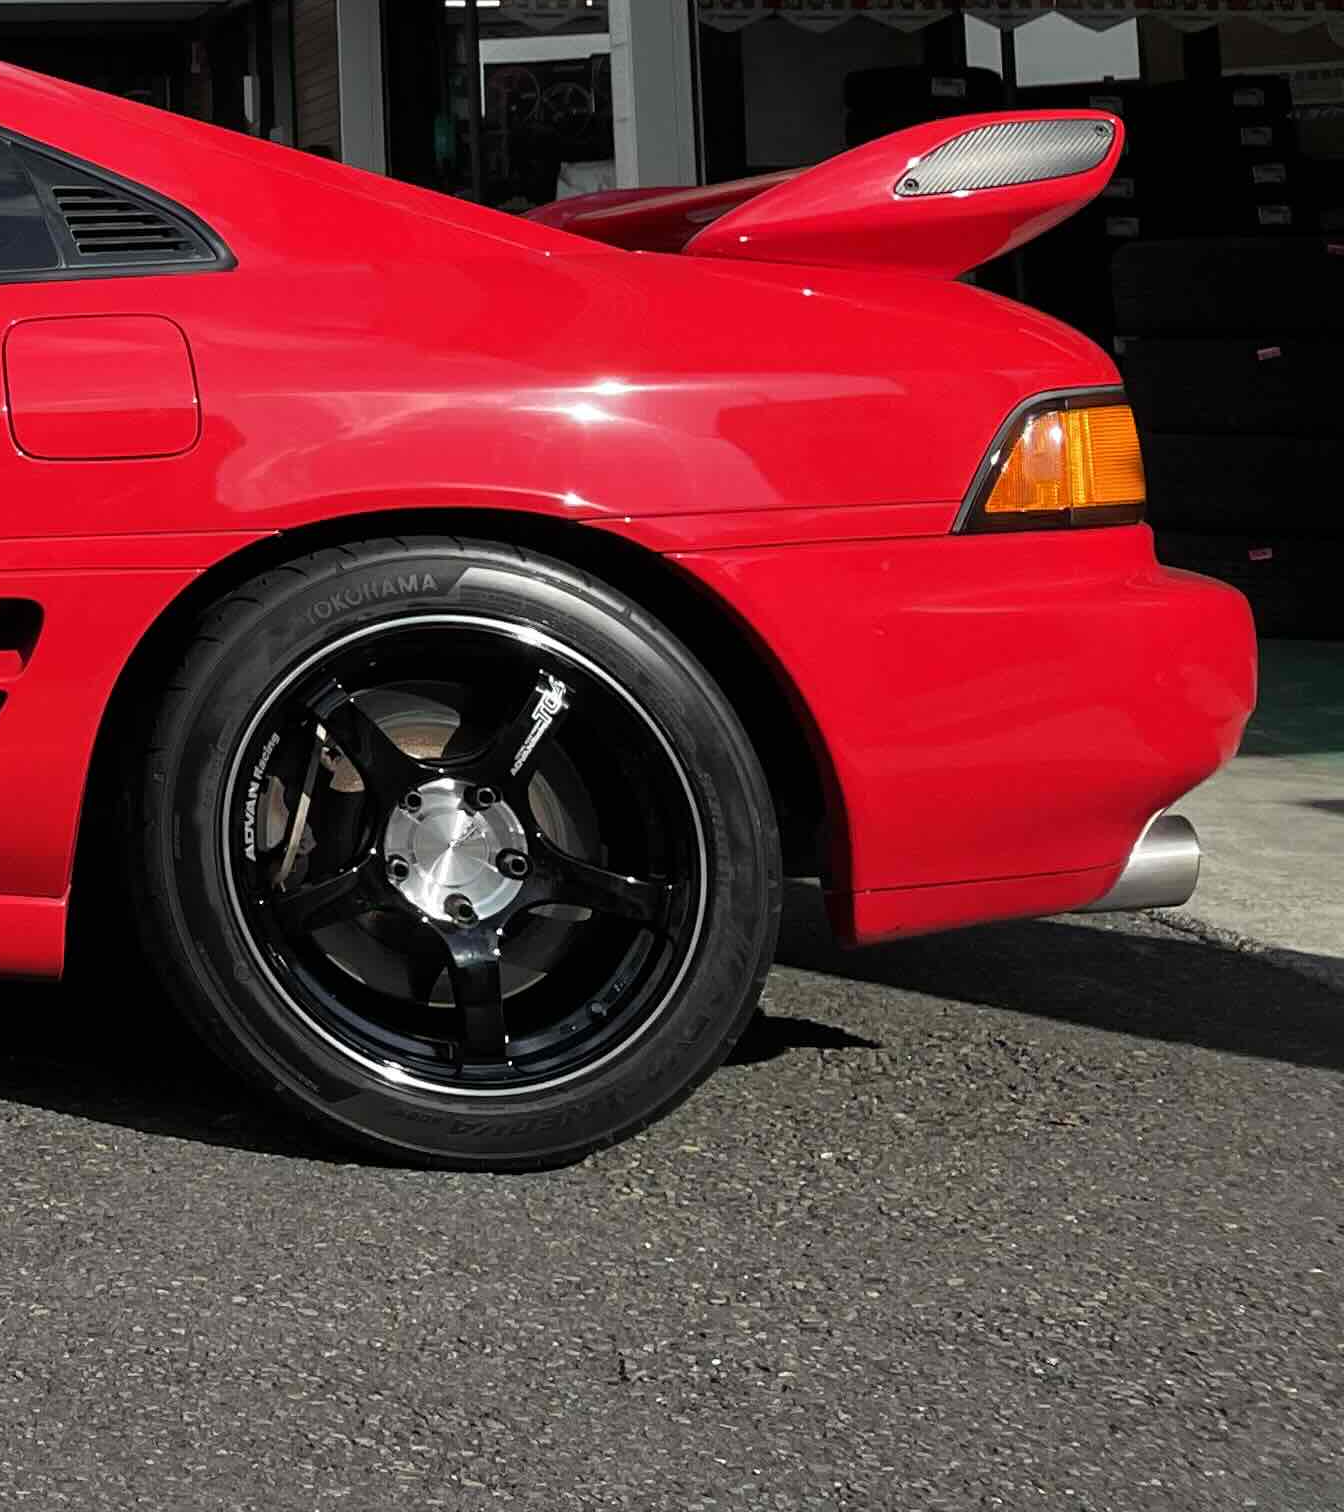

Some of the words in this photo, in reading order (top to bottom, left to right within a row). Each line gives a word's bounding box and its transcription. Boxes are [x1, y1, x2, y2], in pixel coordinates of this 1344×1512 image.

[305, 572, 439, 625] YOKOHAMA
[243, 780, 261, 863] ADVAN
[253, 732, 281, 780] Racing
